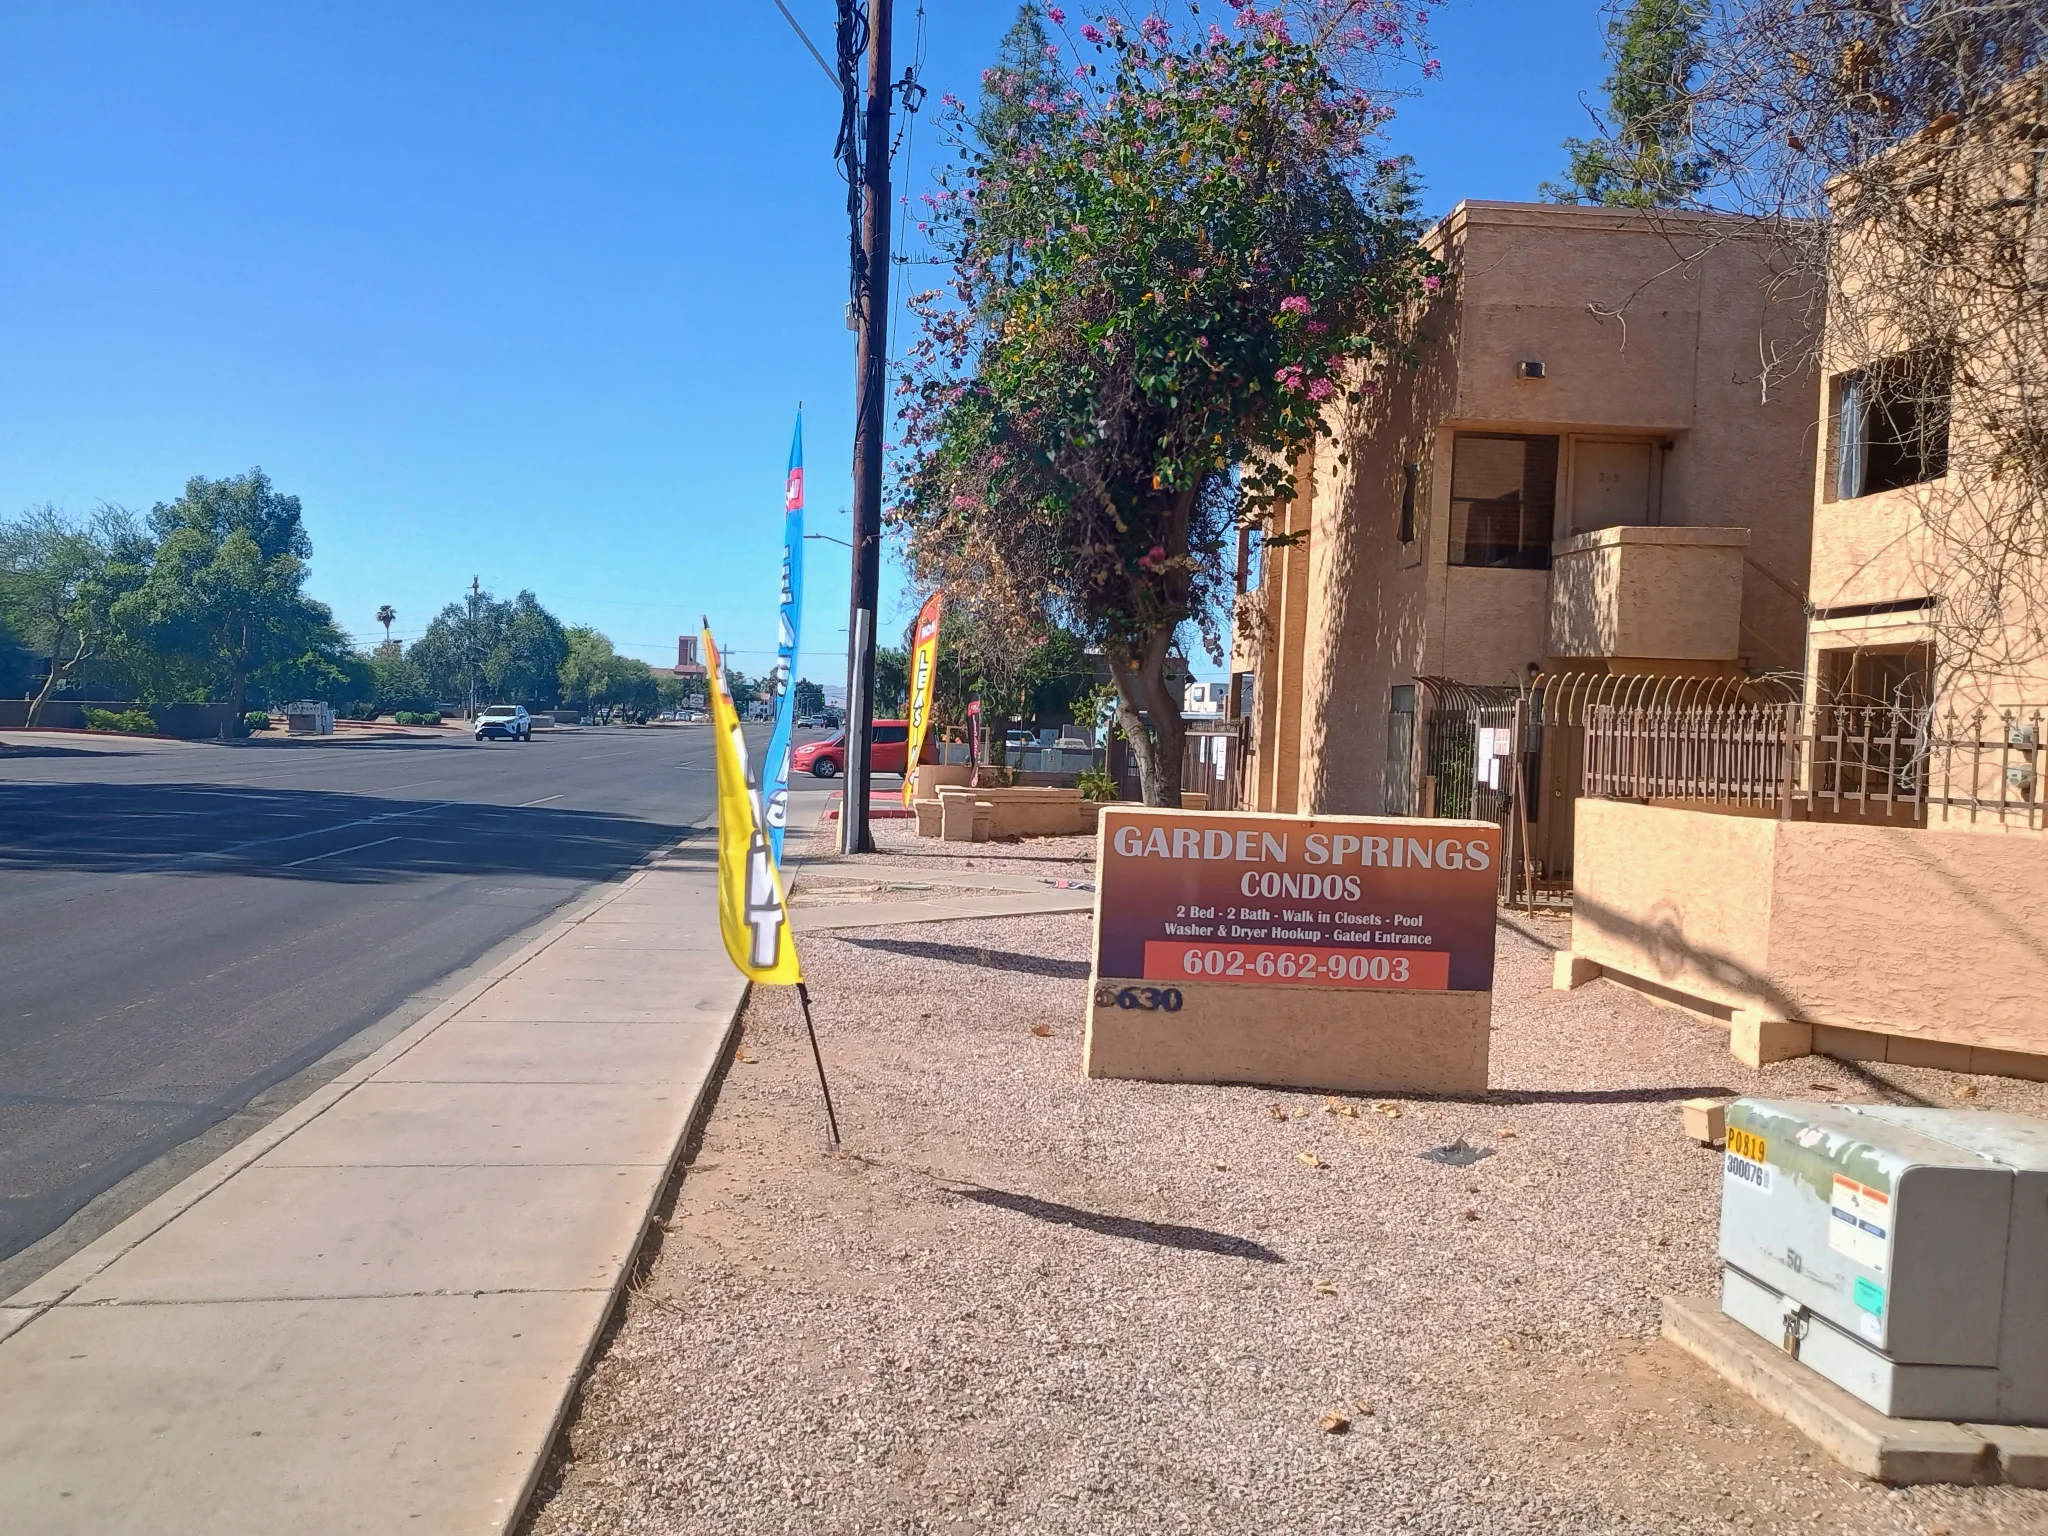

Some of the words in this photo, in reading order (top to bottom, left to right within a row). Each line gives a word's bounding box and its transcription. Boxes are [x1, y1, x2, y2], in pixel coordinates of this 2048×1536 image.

[1113, 826, 1288, 863] GARDEN
[1304, 833, 1490, 871] SPRINGS
[1240, 871, 1361, 901] CONDOS
[1176, 905, 1186, 918] 2
[1189, 905, 1215, 919] Bed
[1226, 907, 1236, 920] 2
[1240, 907, 1270, 921] Bath
[1282, 909, 1314, 923] Walk
[1317, 910, 1331, 923] in
[1334, 911, 1382, 926] Closets
[1393, 914, 1423, 927] Pool
[1164, 922, 1214, 937] Washer
[1217, 924, 1228, 937] &
[1231, 925, 1268, 940] Dryer
[1271, 926, 1321, 942] Hookup
[1333, 928, 1371, 943] Gated
[1374, 930, 1433, 945] Entrance
[1183, 949, 1410, 982] 602-662-9003
[1727, 1127, 1765, 1164] P0819
[1727, 1154, 1763, 1187] 300076
